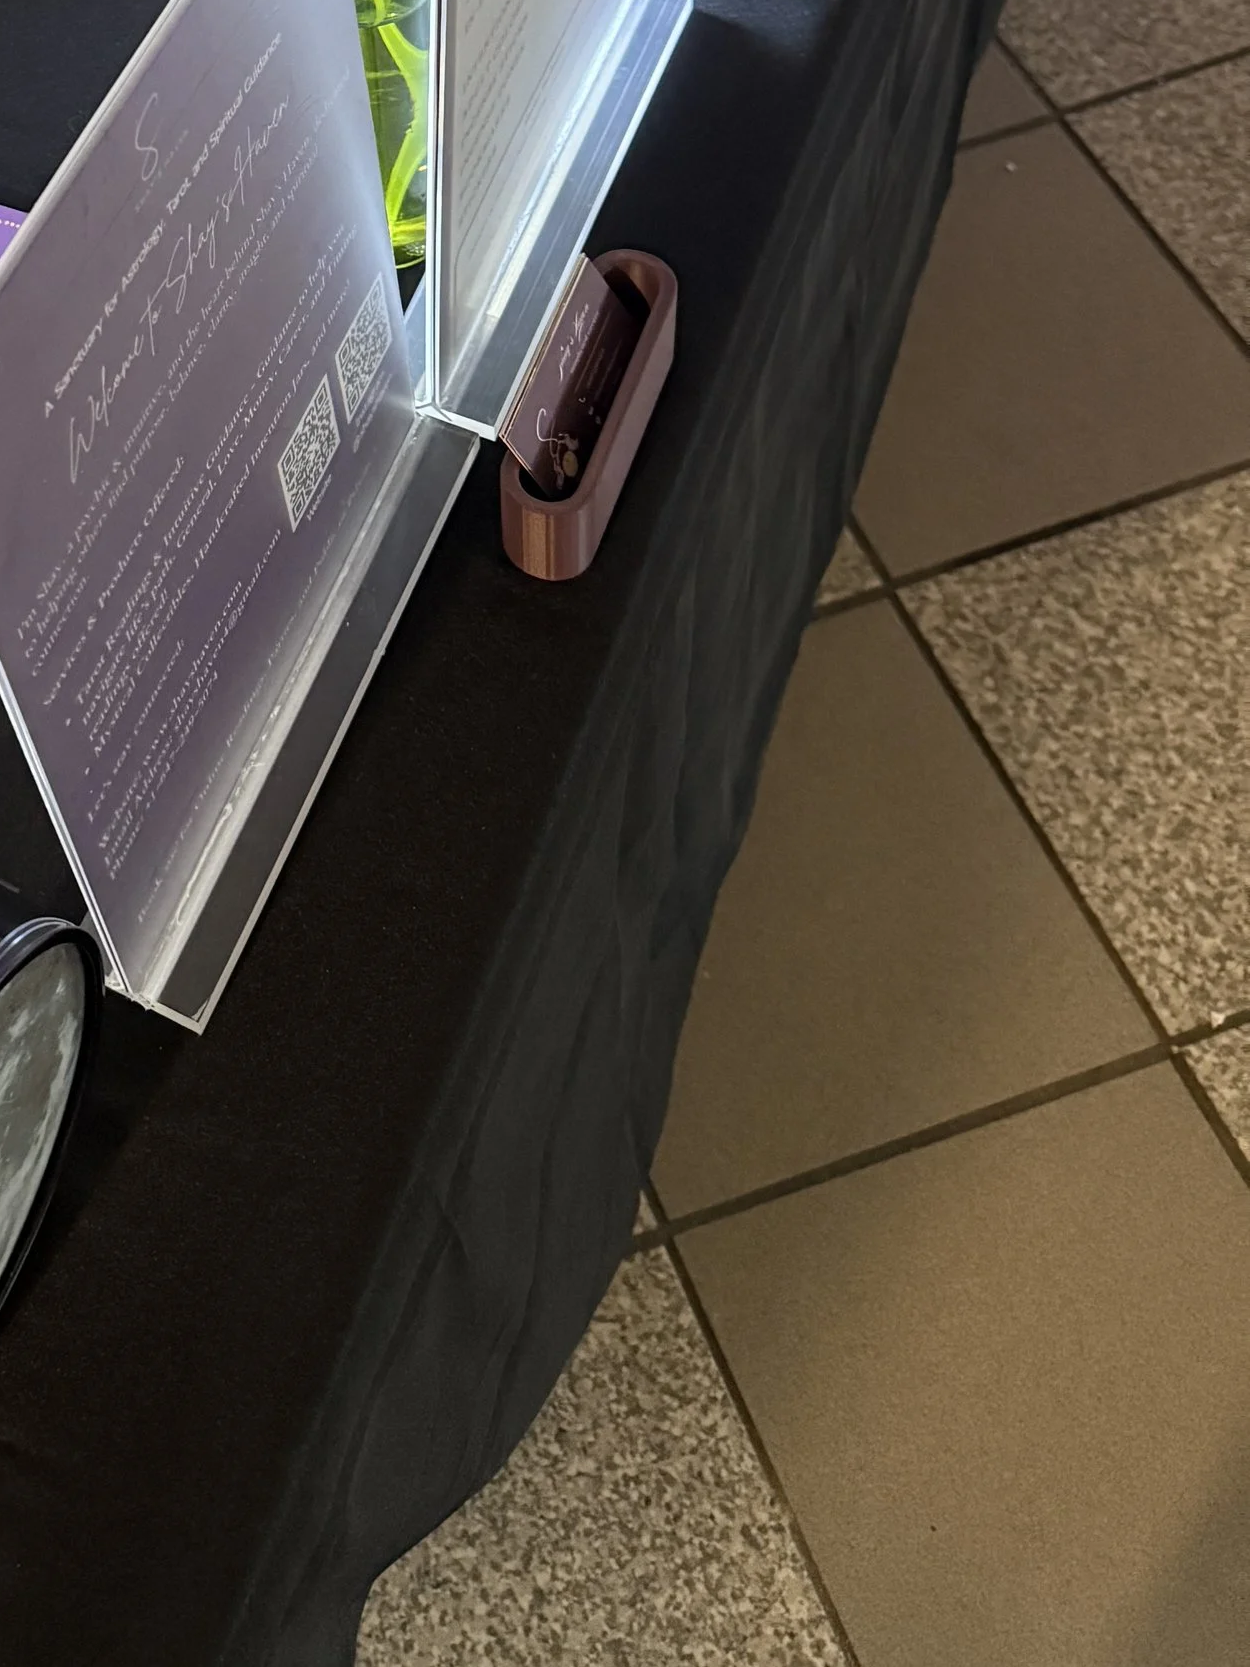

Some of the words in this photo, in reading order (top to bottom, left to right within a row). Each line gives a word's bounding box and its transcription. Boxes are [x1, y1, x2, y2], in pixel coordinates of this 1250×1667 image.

[42, 394, 54, 420] A
[53, 315, 105, 401] Sanctuary
[103, 290, 120, 320] for
[191, 142, 209, 180] and
[208, 86, 243, 152] Spiritual
[243, 28, 282, 98] Guidance
[166, 342, 185, 382] and
[183, 317, 201, 350] the
[199, 273, 224, 324] heart
[224, 220, 256, 283] behind
[309, 273, 326, 312] and
[35, 564, 78, 637] helping
[76, 507, 108, 567] others
[106, 465, 129, 511] find
[75, 650, 106, 709] Tarot
[105, 565, 153, 654] Readings
[151, 546, 162, 570] &
[162, 470, 205, 549] Intuitive
[204, 389, 249, 474] Guidance
[255, 304, 297, 384] Guidance
[297, 285, 308, 308] to
[308, 250, 327, 289] help
[85, 608, 98, 634] &
[97, 527, 144, 612] Products
[141, 447, 185, 531] Offered:
[92, 674, 136, 758] Mystical
[193, 461, 250, 572] Handcrafted
[250, 388, 291, 467] Intention
[310, 321, 326, 357] and
[87, 658, 132, 743] readings
